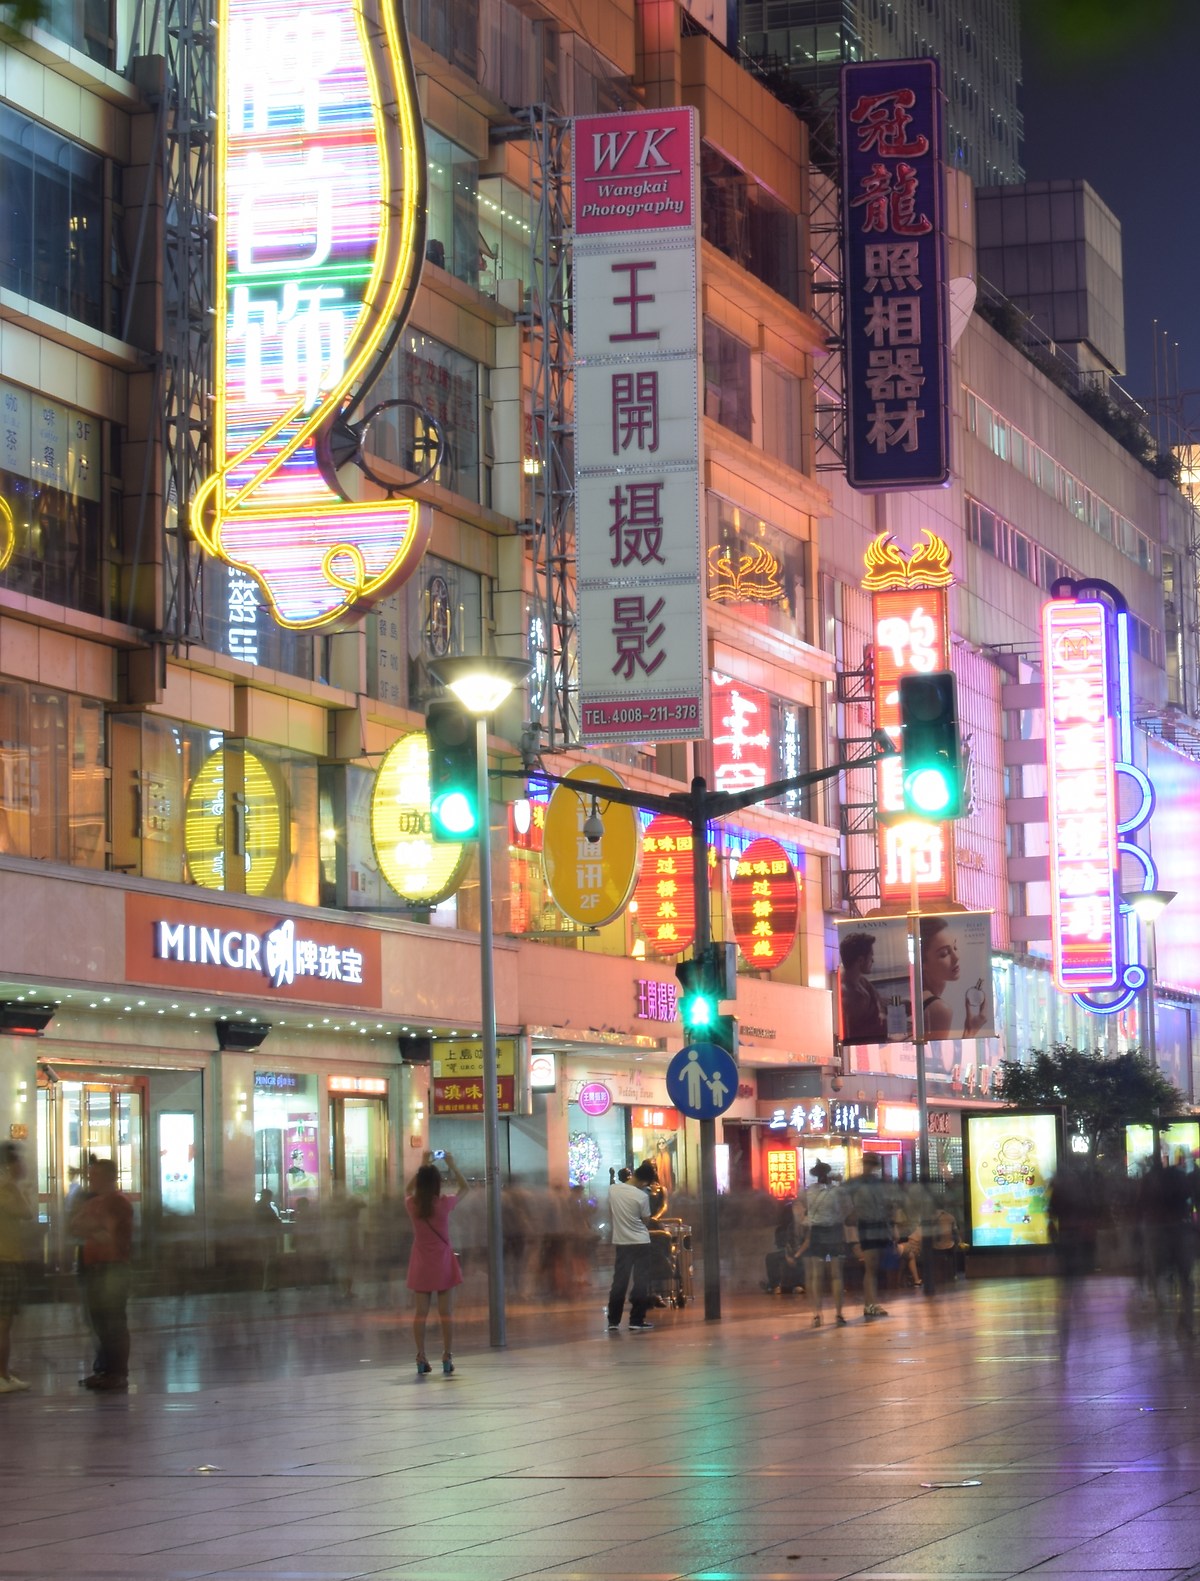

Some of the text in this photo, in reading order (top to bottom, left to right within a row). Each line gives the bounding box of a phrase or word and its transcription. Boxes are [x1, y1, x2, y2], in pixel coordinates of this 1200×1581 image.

[592, 127, 676, 173] WK
[598, 180, 668, 198] Wangkai
[581, 197, 685, 217] Photography
[76, 420, 91, 440] 3F
[580, 894, 600, 909] 2F
[656, 857, 678, 941] 过桥米线
[751, 880, 774, 957] 过桥米线
[160, 920, 262, 971] MINGR
[769, 1104, 827, 1132] 三希堂
